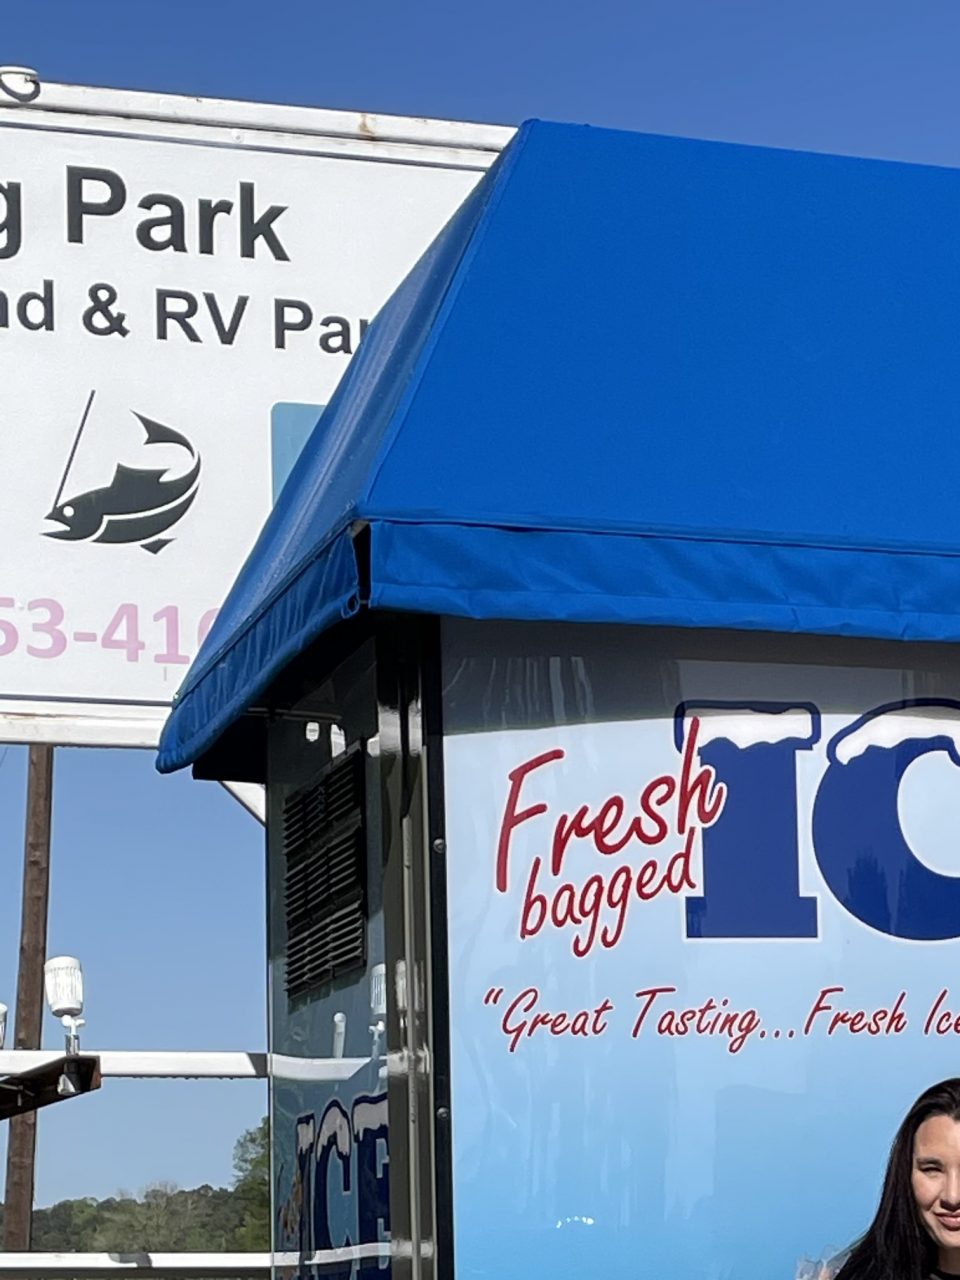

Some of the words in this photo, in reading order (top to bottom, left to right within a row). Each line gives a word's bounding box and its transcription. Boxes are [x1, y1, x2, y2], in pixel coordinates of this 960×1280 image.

[66, 164, 291, 263] Park
[82, 282, 130, 337] &
[155, 287, 250, 346] RV
[496, 715, 725, 893] Fresh
[520, 826, 696, 957] bagged
